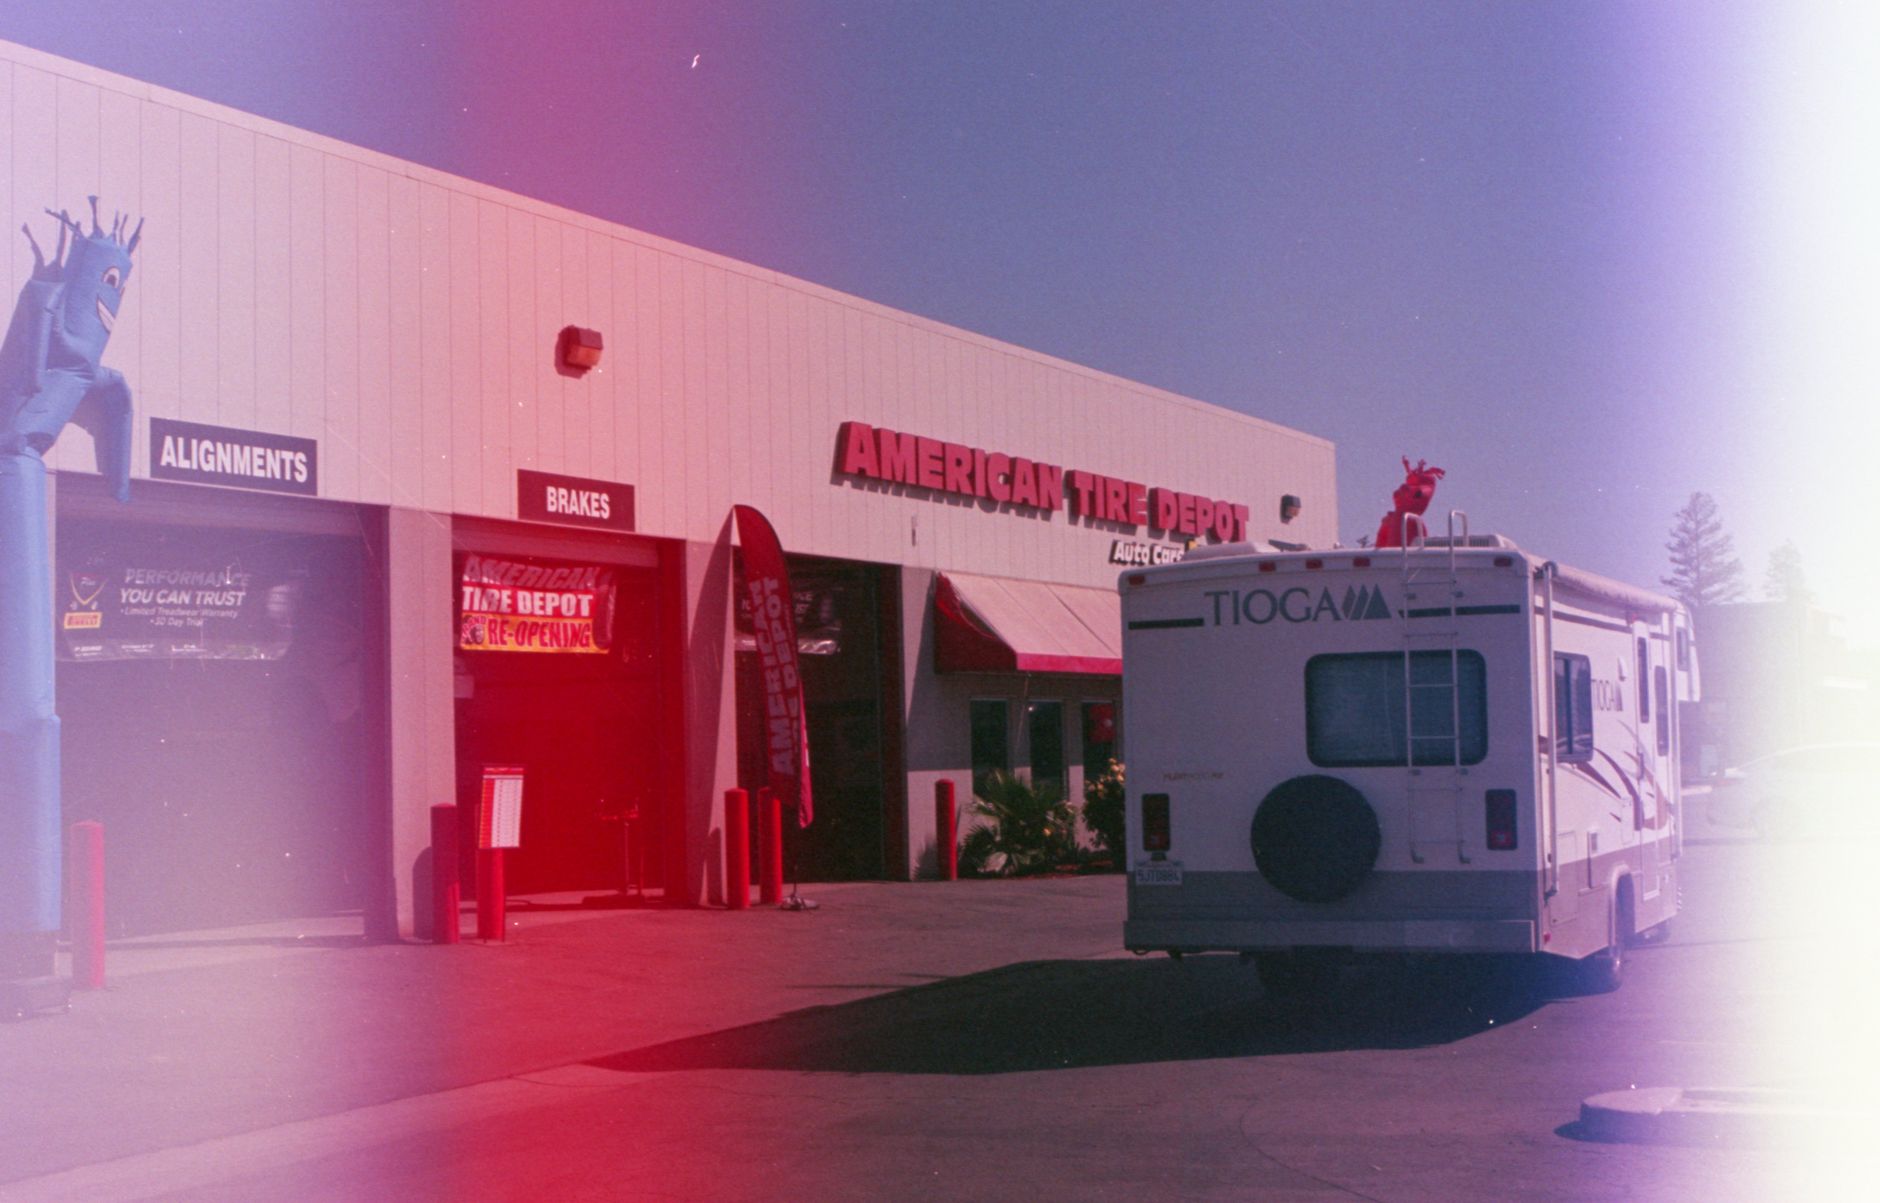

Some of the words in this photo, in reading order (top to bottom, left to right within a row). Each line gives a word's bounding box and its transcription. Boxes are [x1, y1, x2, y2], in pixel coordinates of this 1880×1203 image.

[159, 435, 308, 483] ALIGNMENTS
[840, 421, 1063, 511] AMERICAN
[1071, 469, 1149, 526] TIRE
[1156, 488, 1249, 542] DEPOT
[546, 486, 610, 519] BRAKES
[1114, 541, 1150, 565] Auto
[125, 567, 252, 588] PERFORMANCE
[463, 555, 600, 590] AMERICAN
[119, 588, 154, 605] YOU
[156, 589, 192, 606] CAN
[195, 590, 247, 607] TRUST
[124, 606, 155, 617] Limited
[157, 607, 199, 618] Treadwear
[200, 608, 238, 620] Warranty
[462, 586, 512, 613] TIRE
[517, 590, 593, 617] DEPOT
[1204, 587, 1341, 626] TIOGA
[168, 617, 184, 628] Day
[488, 617, 591, 648] RE-OPENING
[764, 577, 797, 688] DEPOT
[750, 579, 794, 776] AMERICAN
